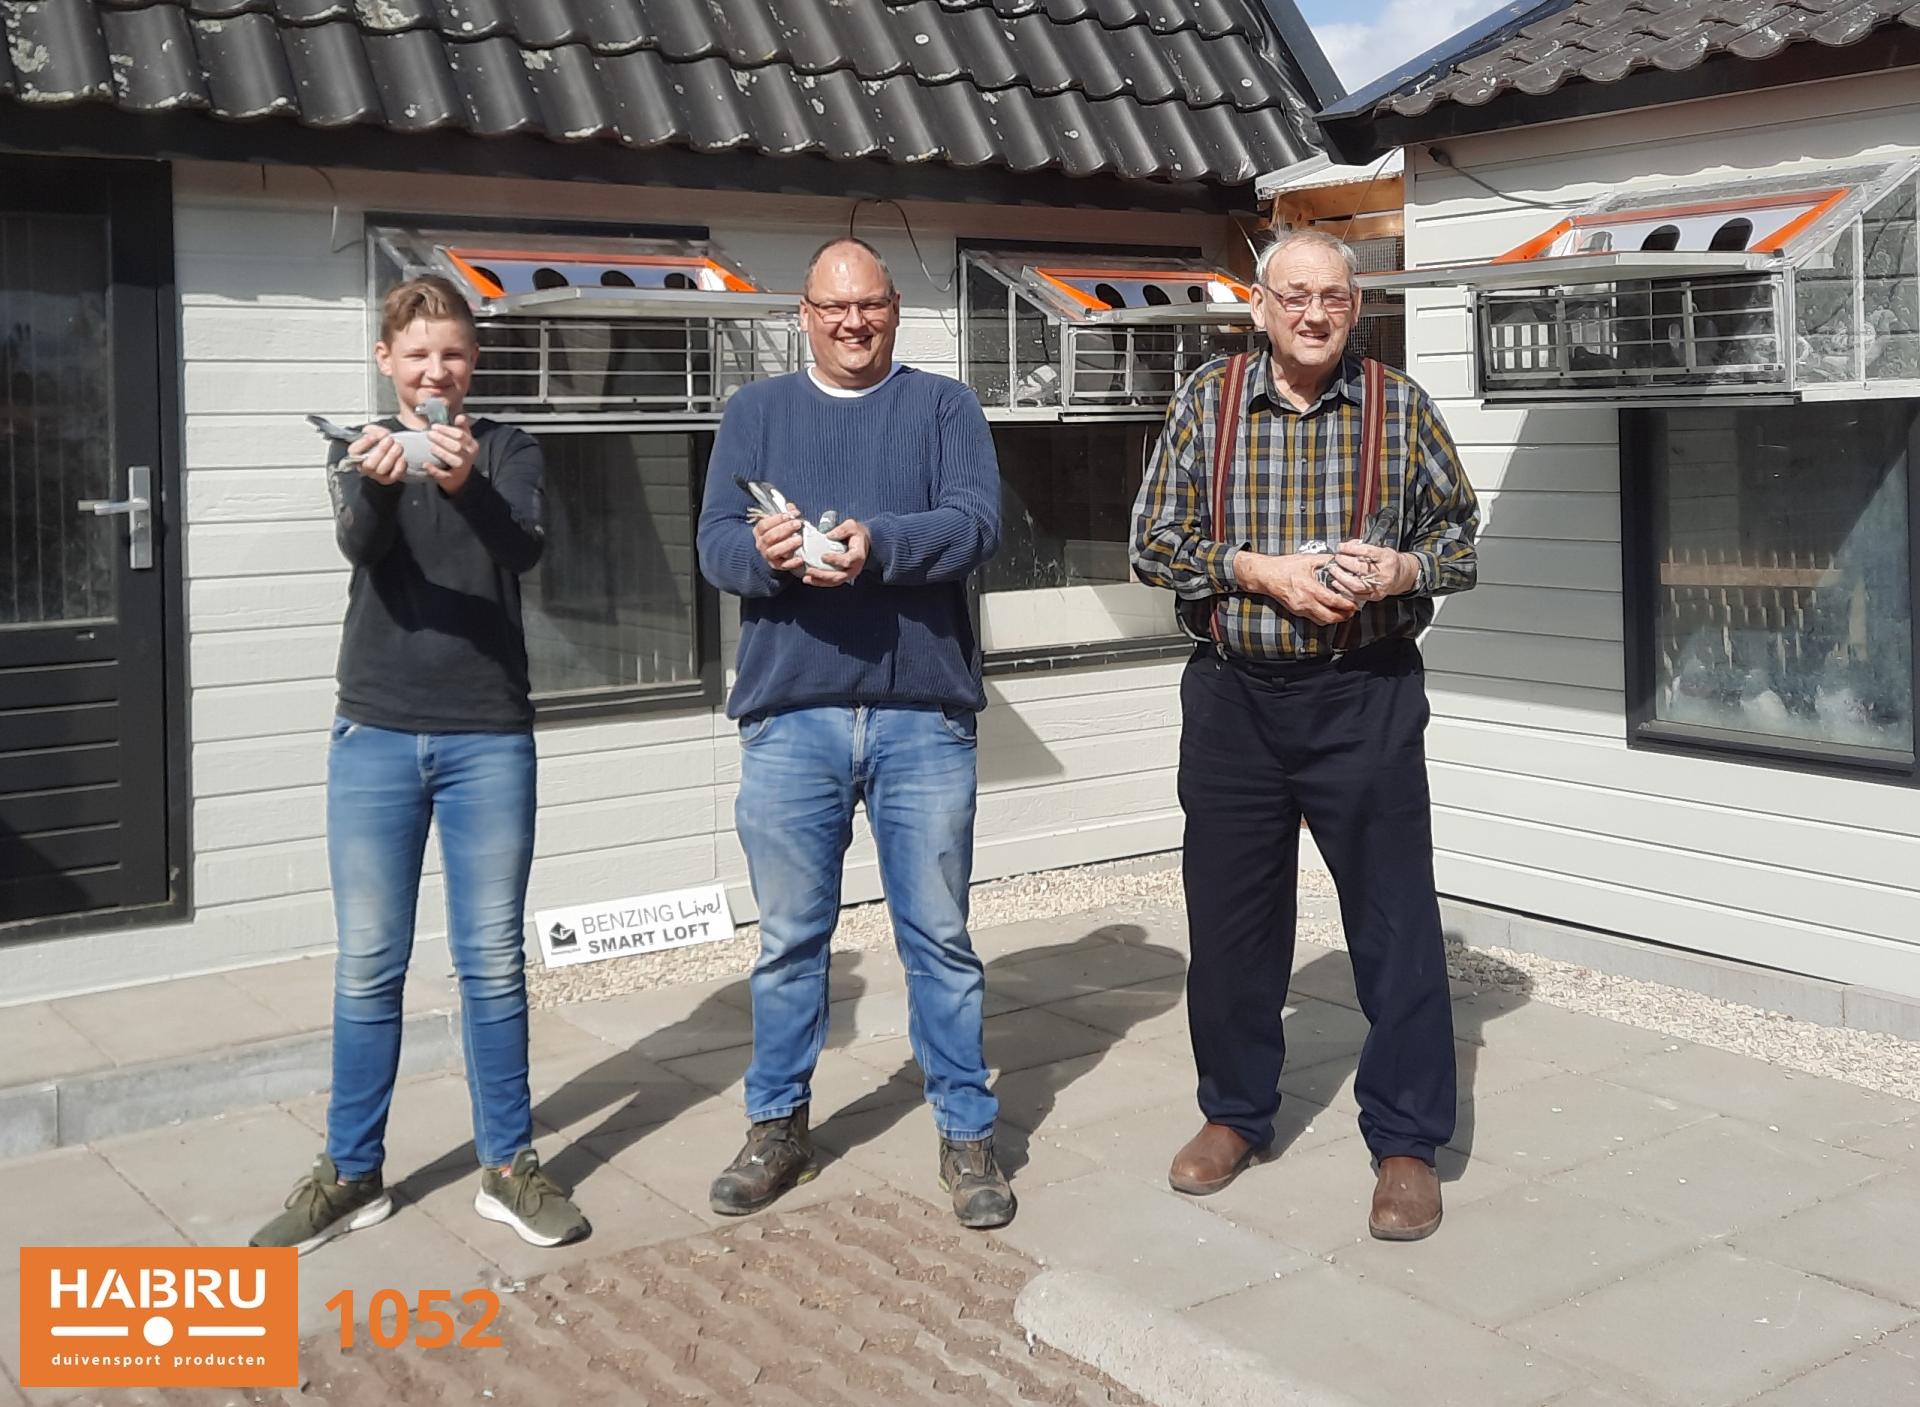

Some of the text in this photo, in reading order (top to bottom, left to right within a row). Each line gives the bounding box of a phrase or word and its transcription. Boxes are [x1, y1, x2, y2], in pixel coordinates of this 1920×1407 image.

[582, 893, 722, 935] BENZING Live!
[588, 922, 711, 954] SMART LOFT
